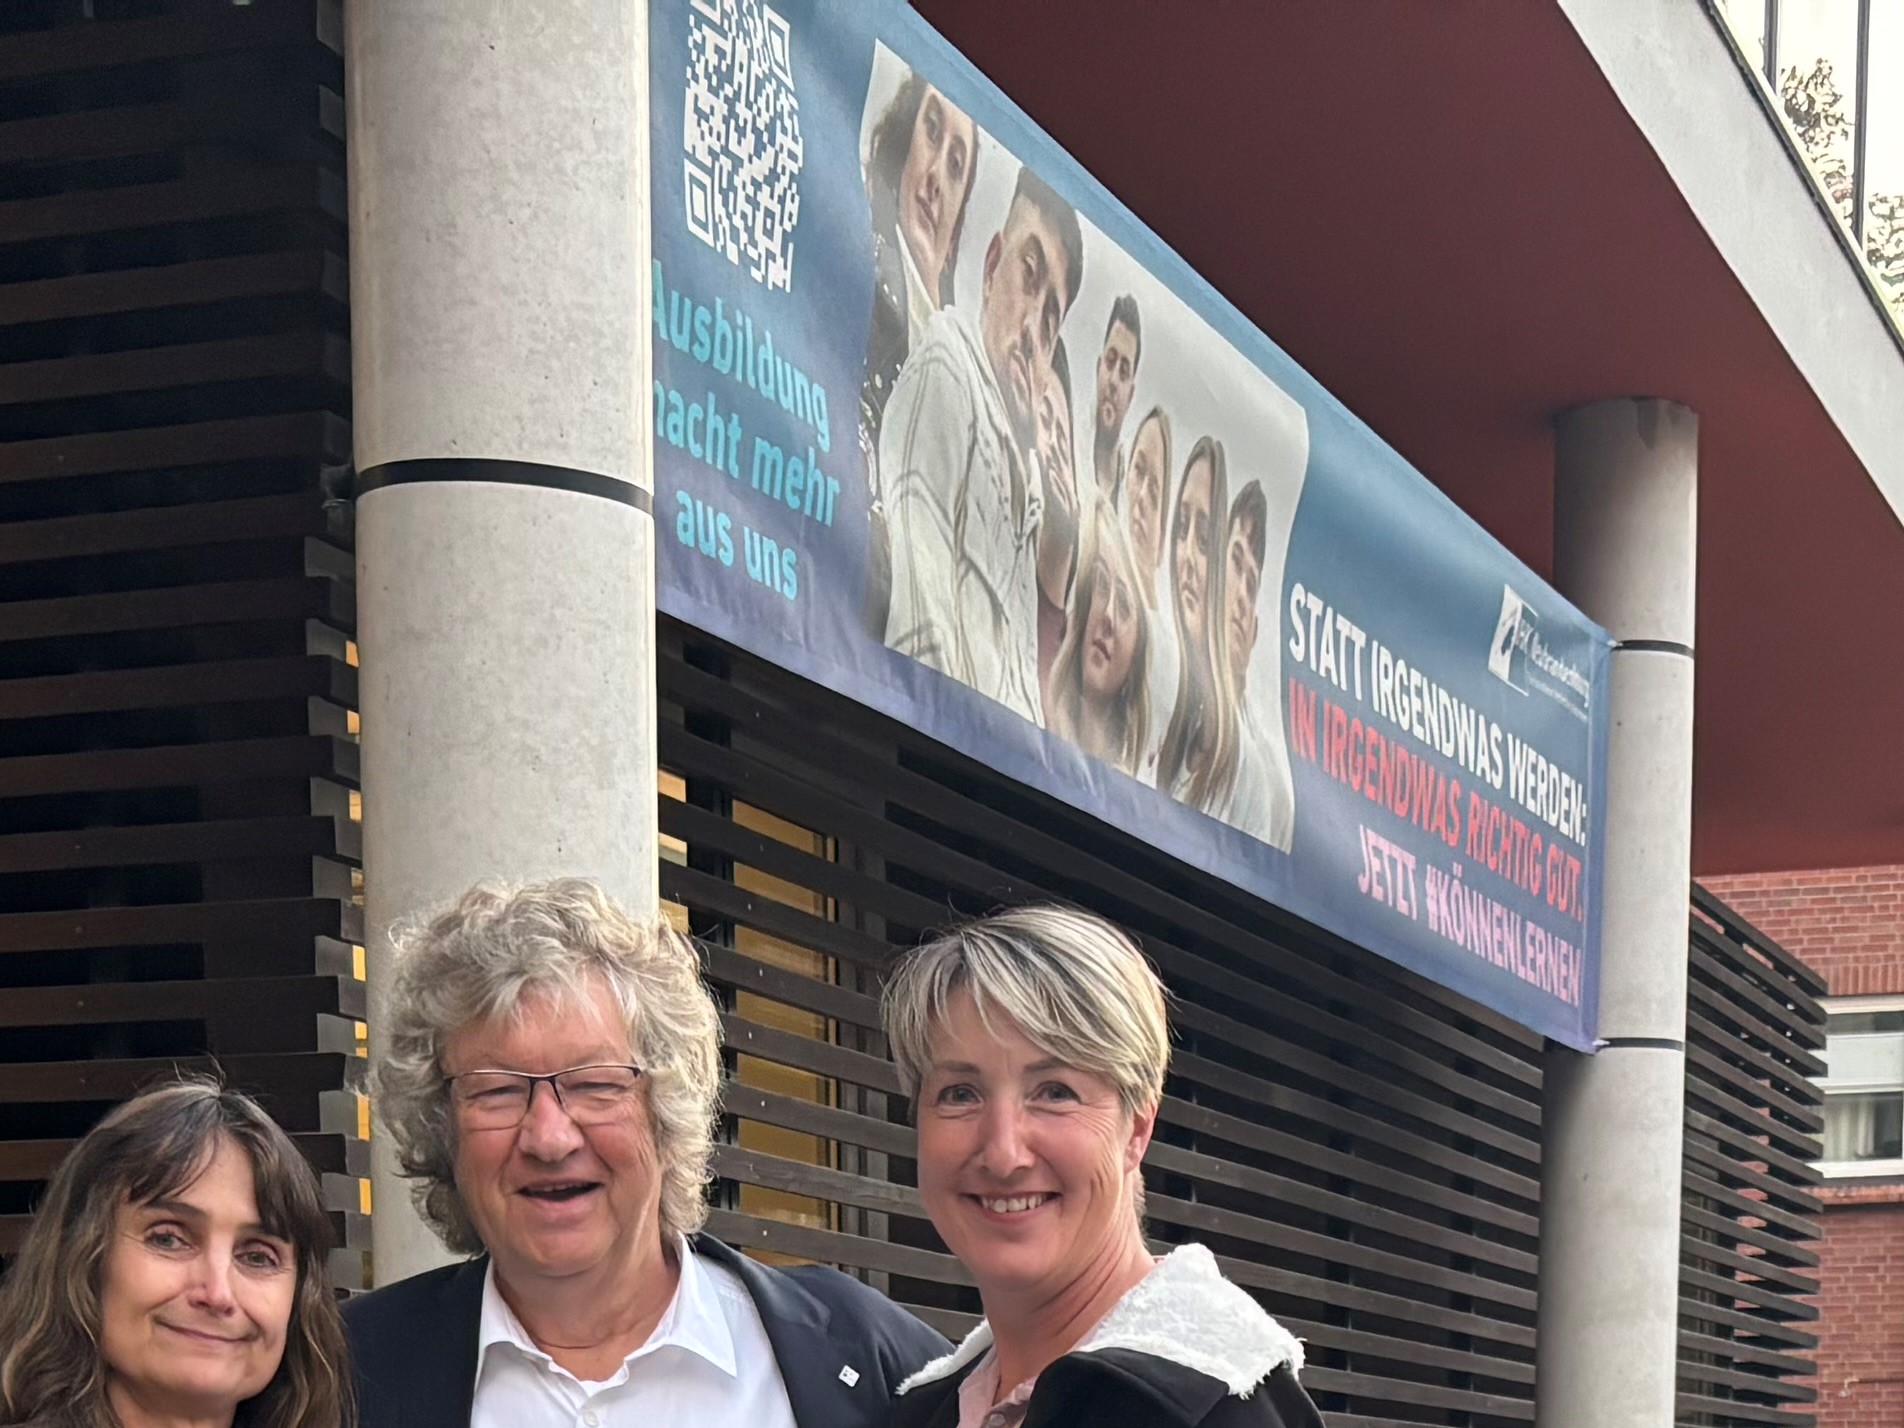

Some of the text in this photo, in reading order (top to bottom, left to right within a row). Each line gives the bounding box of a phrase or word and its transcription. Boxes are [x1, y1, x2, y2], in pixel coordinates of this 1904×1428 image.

[675, 490, 797, 600] aus uns
[752, 436, 841, 528] mehr
[1288, 677, 1583, 922] IN IRGENDWAS RICHTIG GUT.
[1289, 583, 1366, 700] STATT
[1371, 640, 1502, 790] IRGENDWAS
[1507, 733, 1587, 847] WERDEN:
[1358, 824, 1581, 1008] JETZT #KÖNNENLERNEN
